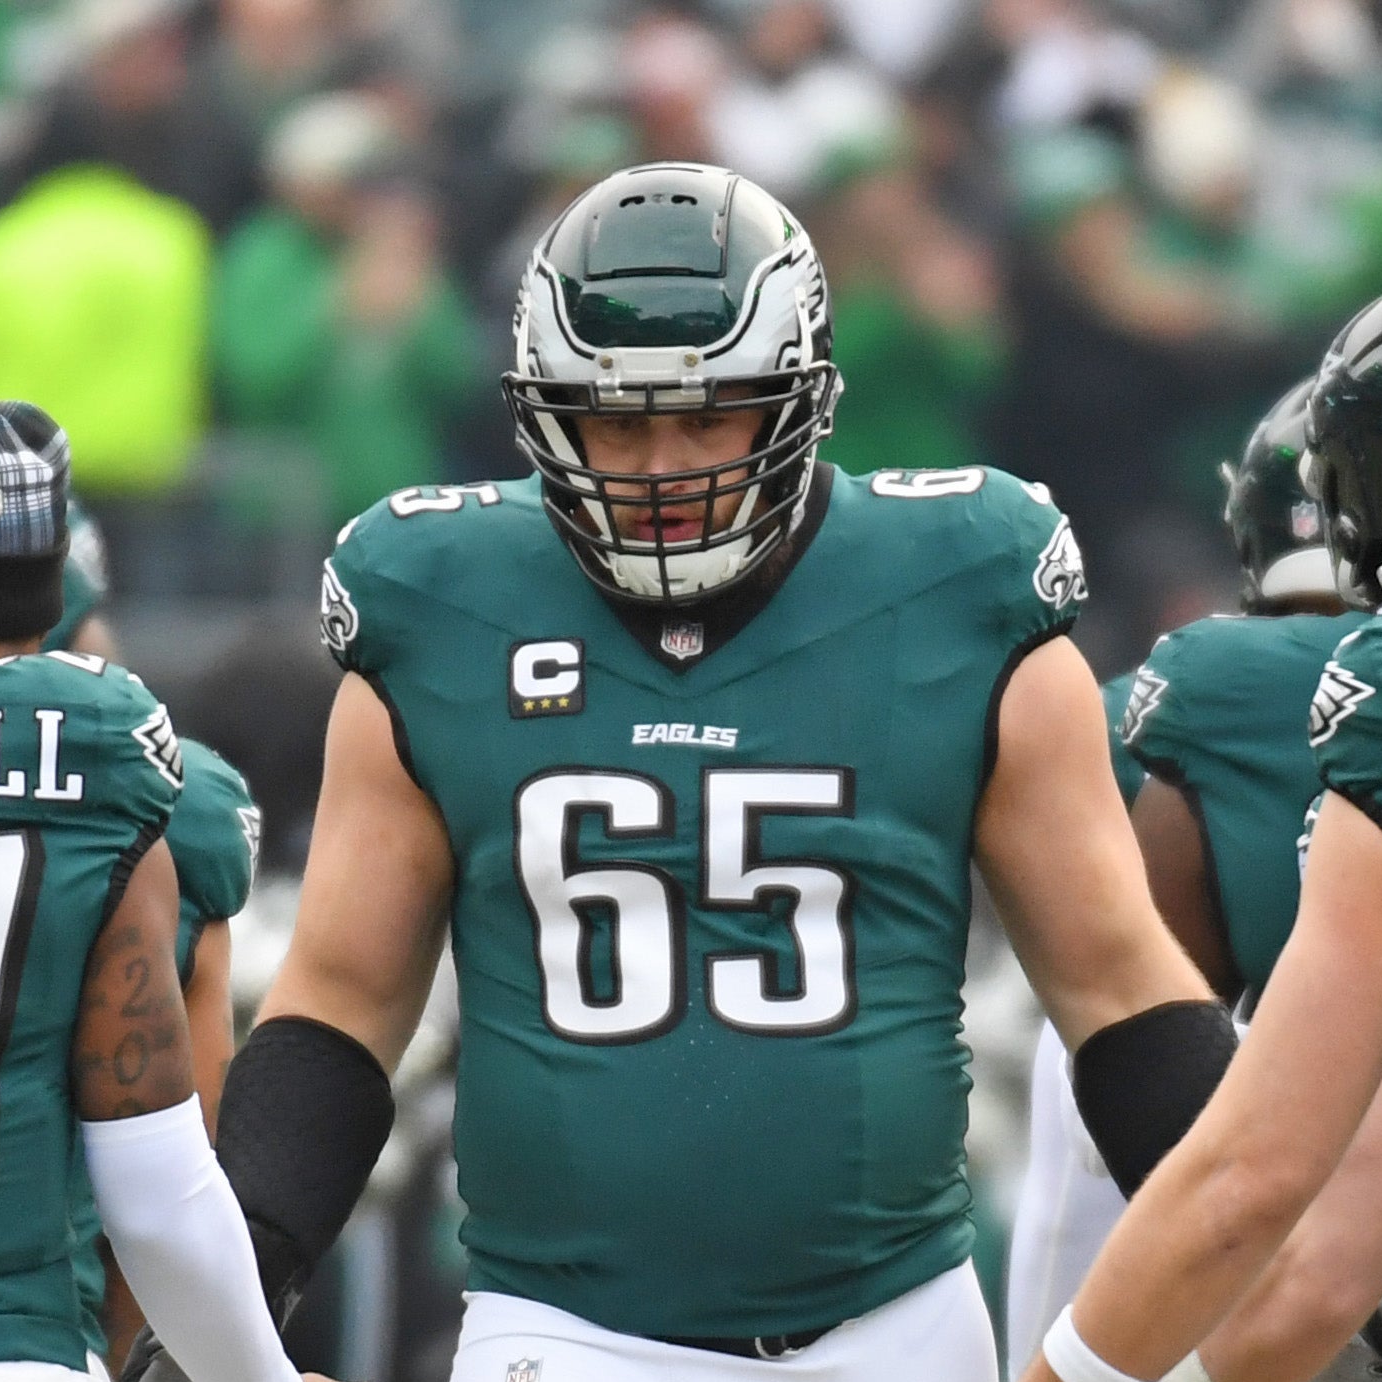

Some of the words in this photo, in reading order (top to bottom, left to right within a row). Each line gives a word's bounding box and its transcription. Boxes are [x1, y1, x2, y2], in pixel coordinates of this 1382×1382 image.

[669, 633, 696, 649] NFL
[513, 641, 580, 697] C
[631, 722, 739, 748] EAGLES
[514, 768, 852, 1040] 65
